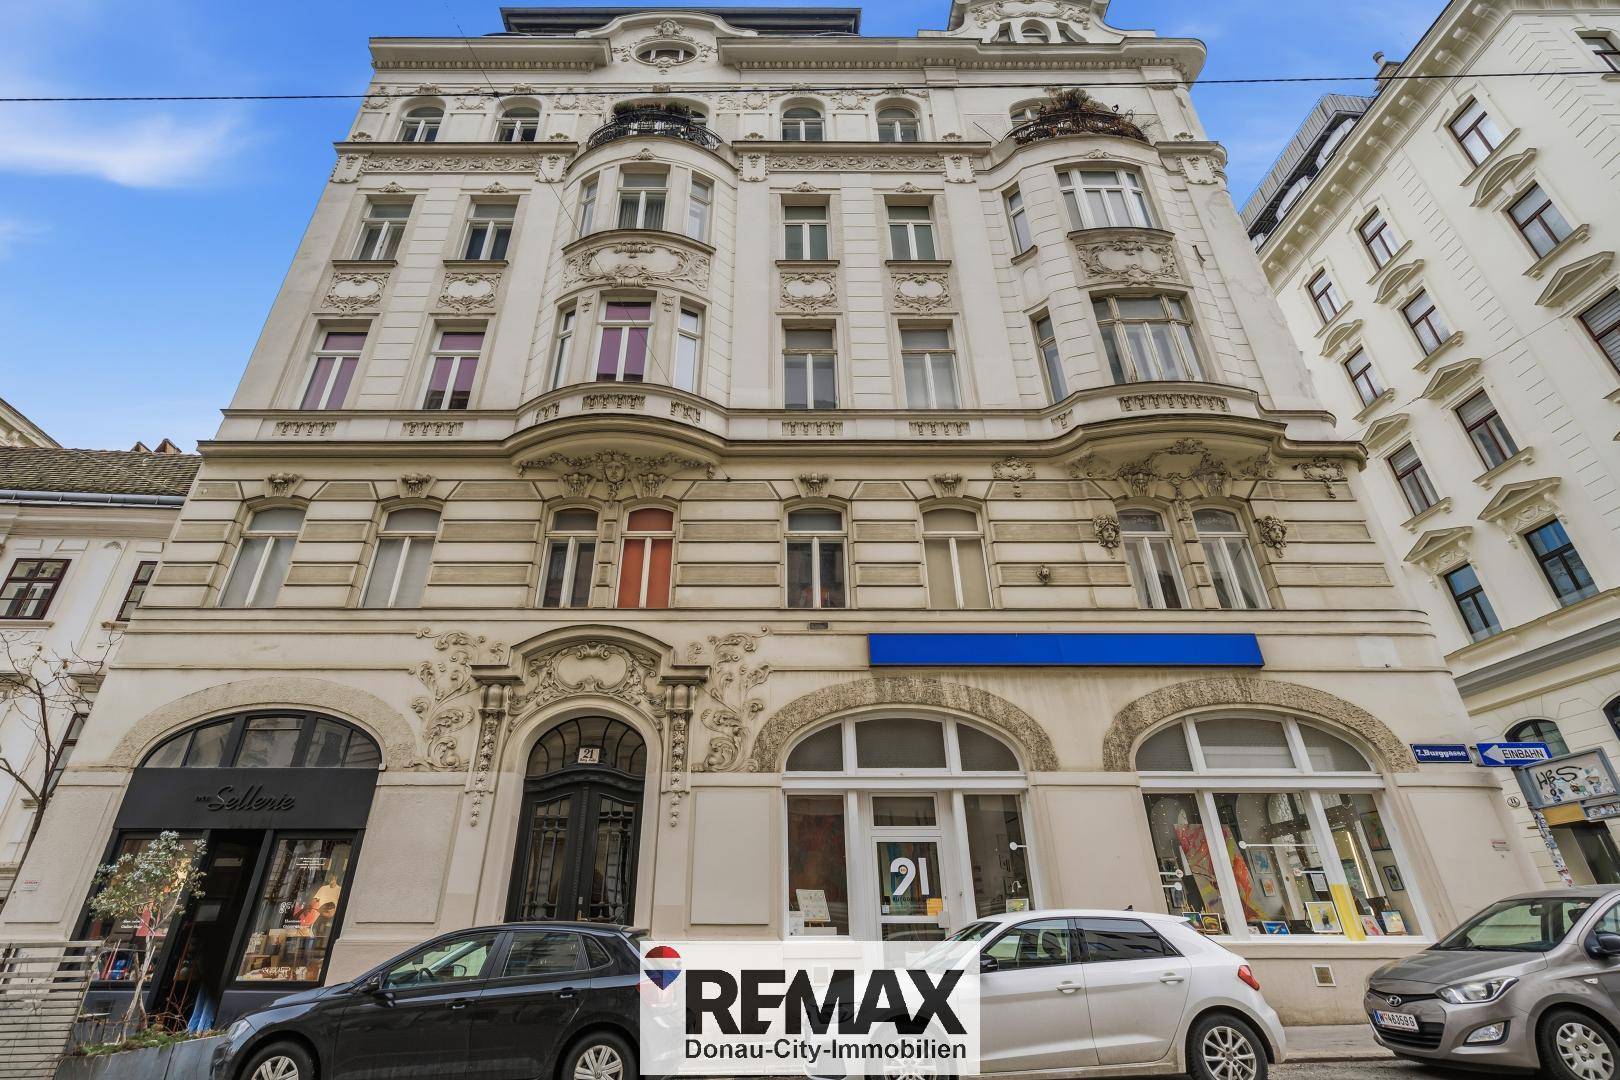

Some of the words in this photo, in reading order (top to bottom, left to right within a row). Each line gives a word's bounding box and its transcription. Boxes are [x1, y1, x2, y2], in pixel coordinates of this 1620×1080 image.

[583, 748, 594, 758] 21
[1423, 749, 1467, 758] Burggasse
[1501, 748, 1545, 759] EINBAHN
[208, 785, 296, 811] Sellerie
